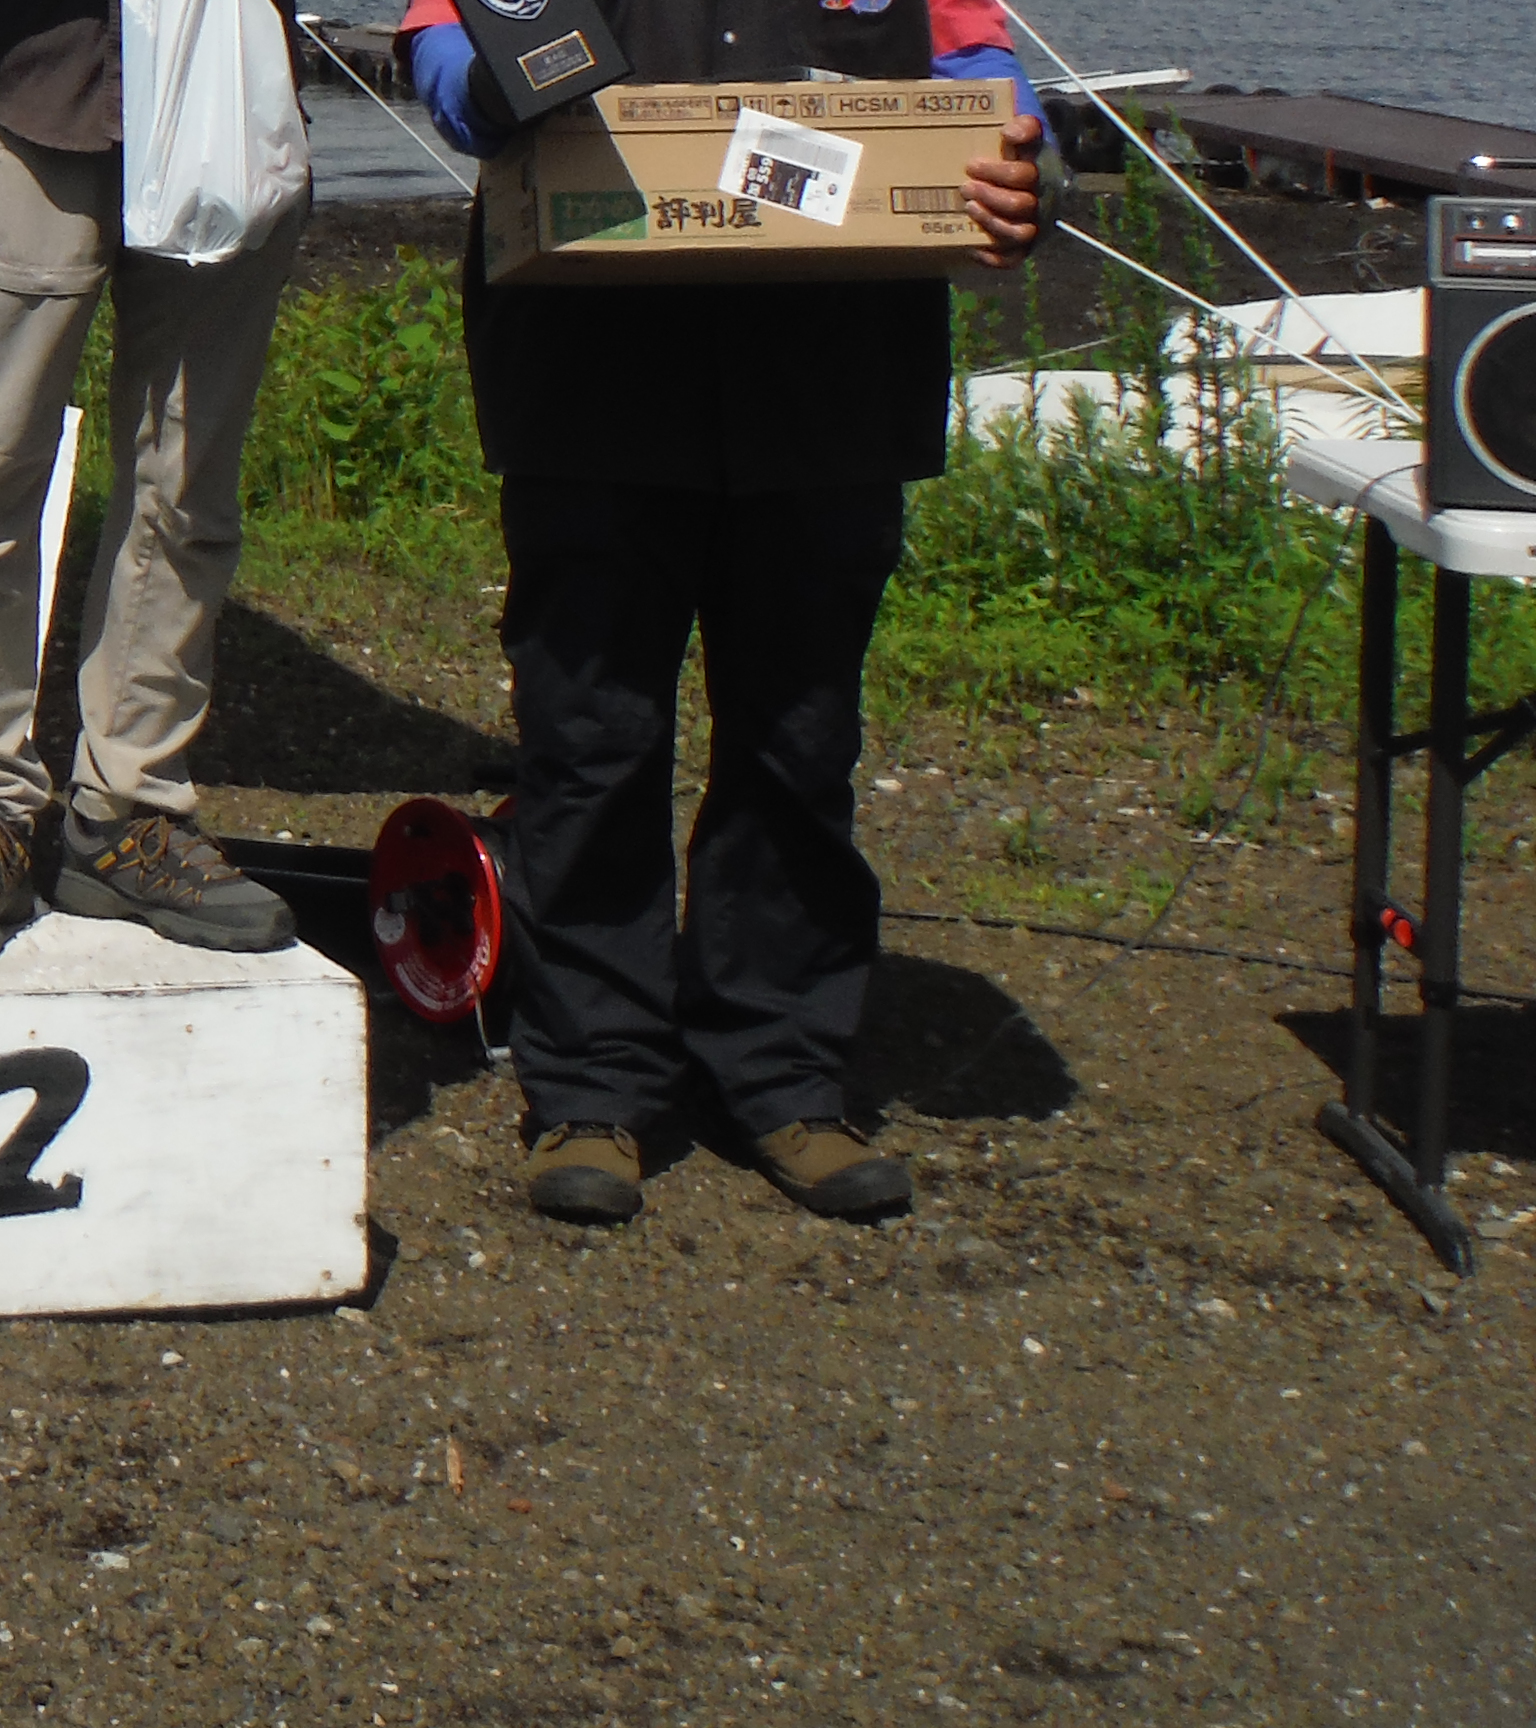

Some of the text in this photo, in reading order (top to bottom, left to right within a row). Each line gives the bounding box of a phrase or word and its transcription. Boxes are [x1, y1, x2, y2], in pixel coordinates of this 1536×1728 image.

[839, 94, 992, 113] HCSM 433770
[653, 195, 763, 233] 評判屋
